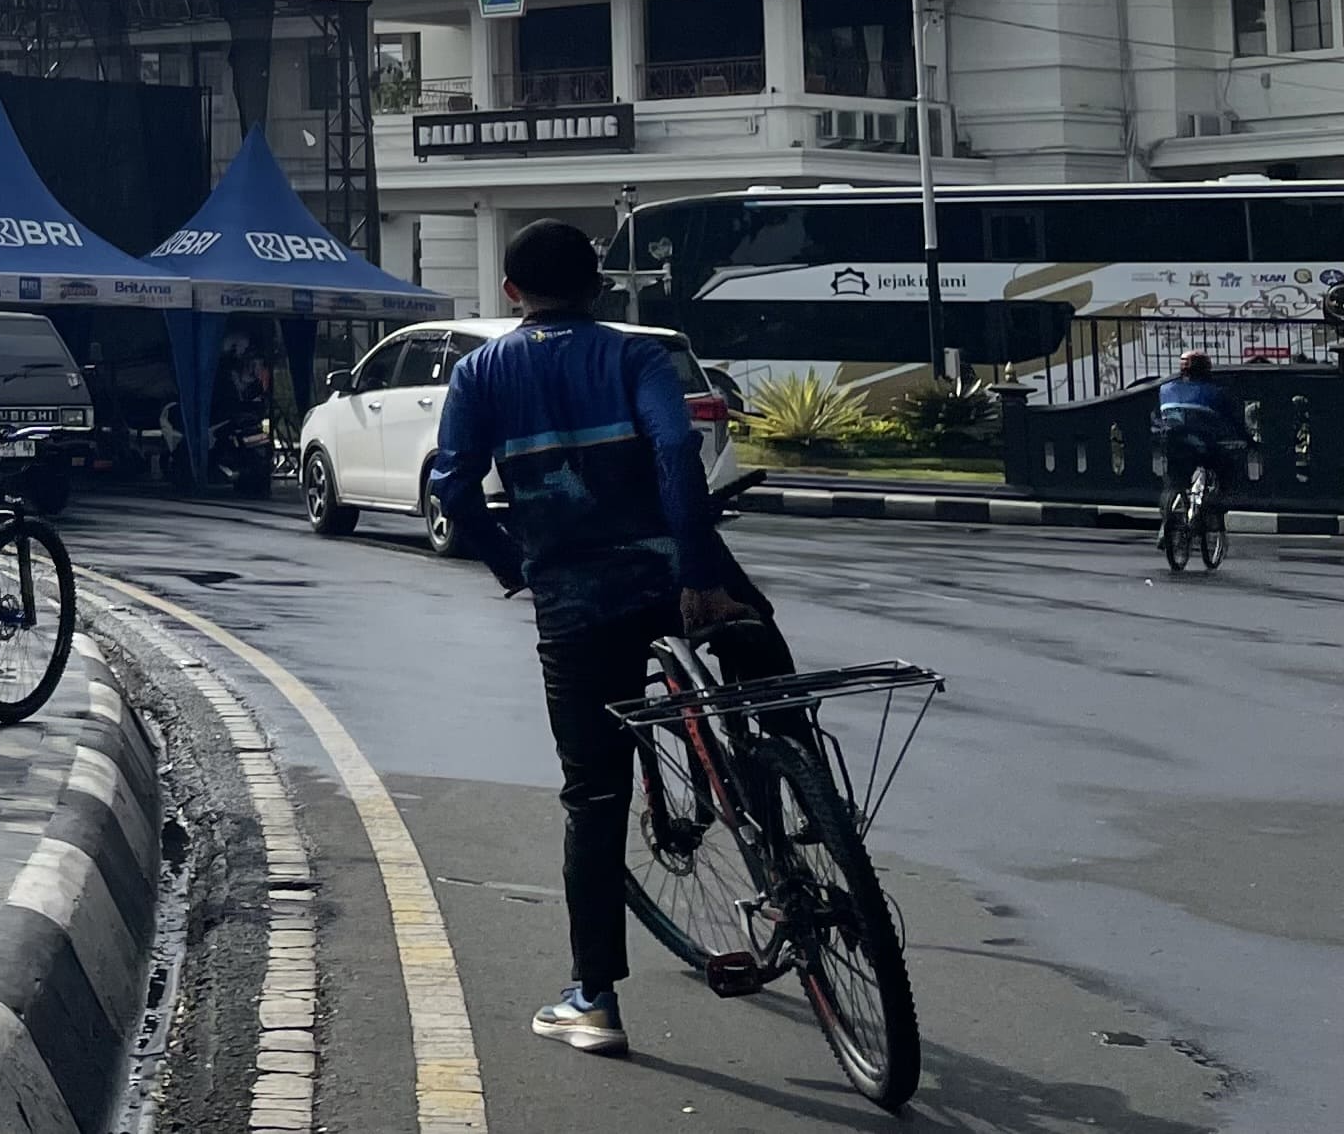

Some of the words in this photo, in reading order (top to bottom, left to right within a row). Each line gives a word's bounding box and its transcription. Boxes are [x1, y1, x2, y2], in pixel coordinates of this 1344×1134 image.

[418, 123, 474, 146] BALAI
[480, 120, 529, 143] KOTA
[535, 115, 618, 140] MALANG
[20, 220, 83, 247] BRI
[175, 231, 221, 255] BRI
[286, 235, 347, 262] BRI
[114, 281, 172, 295] BritAma
[878, 274, 917, 290] jejak
[919, 274, 967, 288] iani
